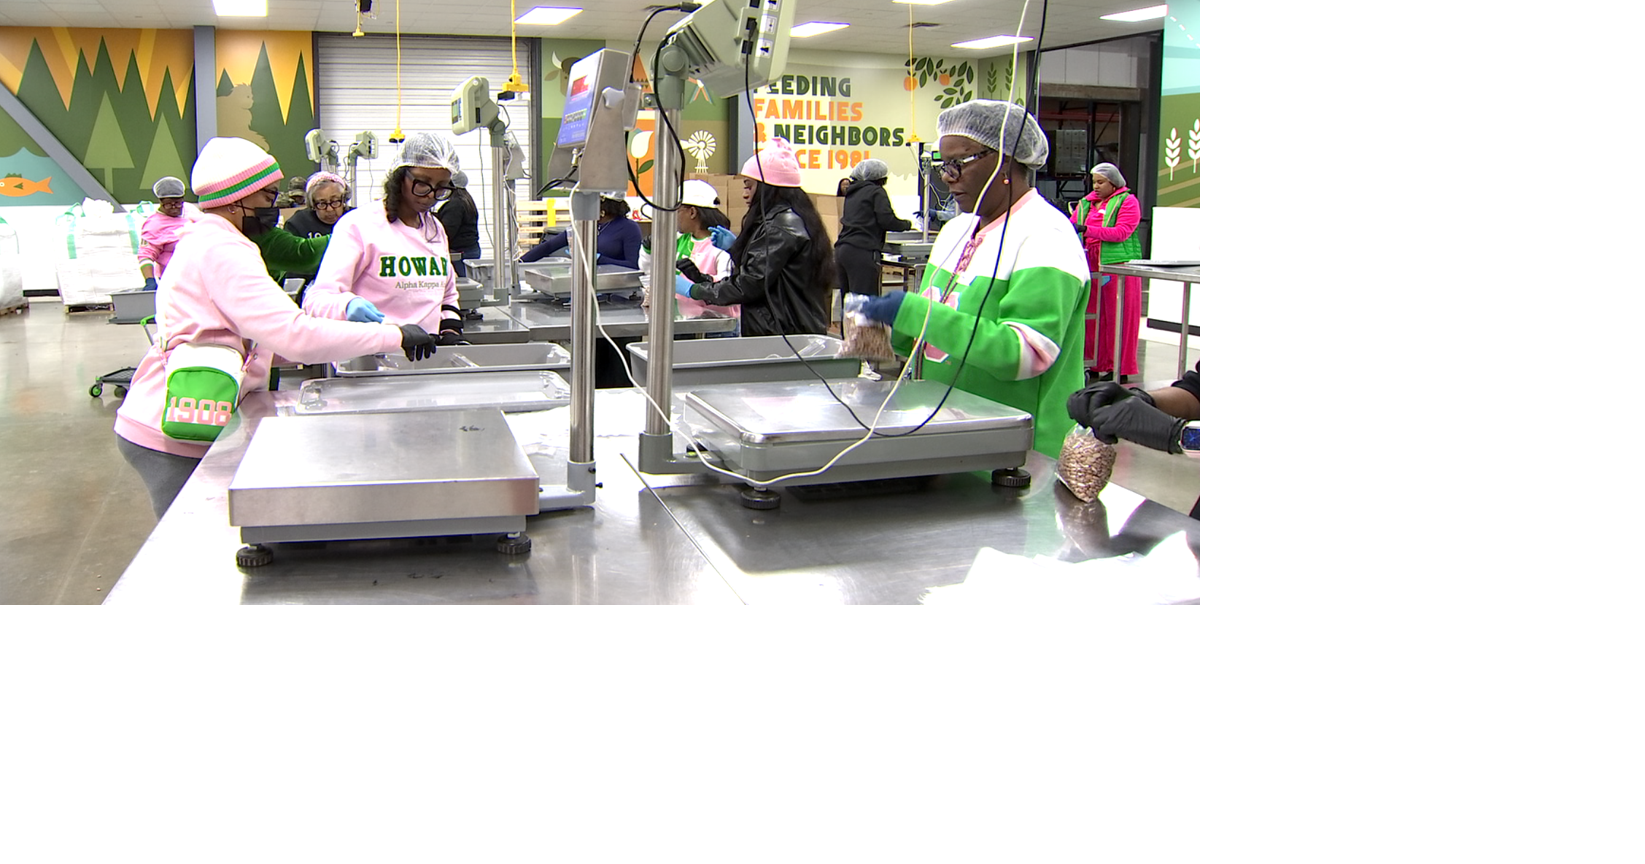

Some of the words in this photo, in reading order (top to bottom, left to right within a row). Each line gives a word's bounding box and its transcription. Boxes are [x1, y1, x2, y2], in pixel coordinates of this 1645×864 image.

[754, 75, 851, 98] EEDING
[754, 99, 863, 122] FAMILIES
[774, 124, 905, 147] NEIGHBORS
[395, 281, 418, 290] Alpha
[419, 281, 440, 289] Kappa
[166, 396, 233, 427] 1908
